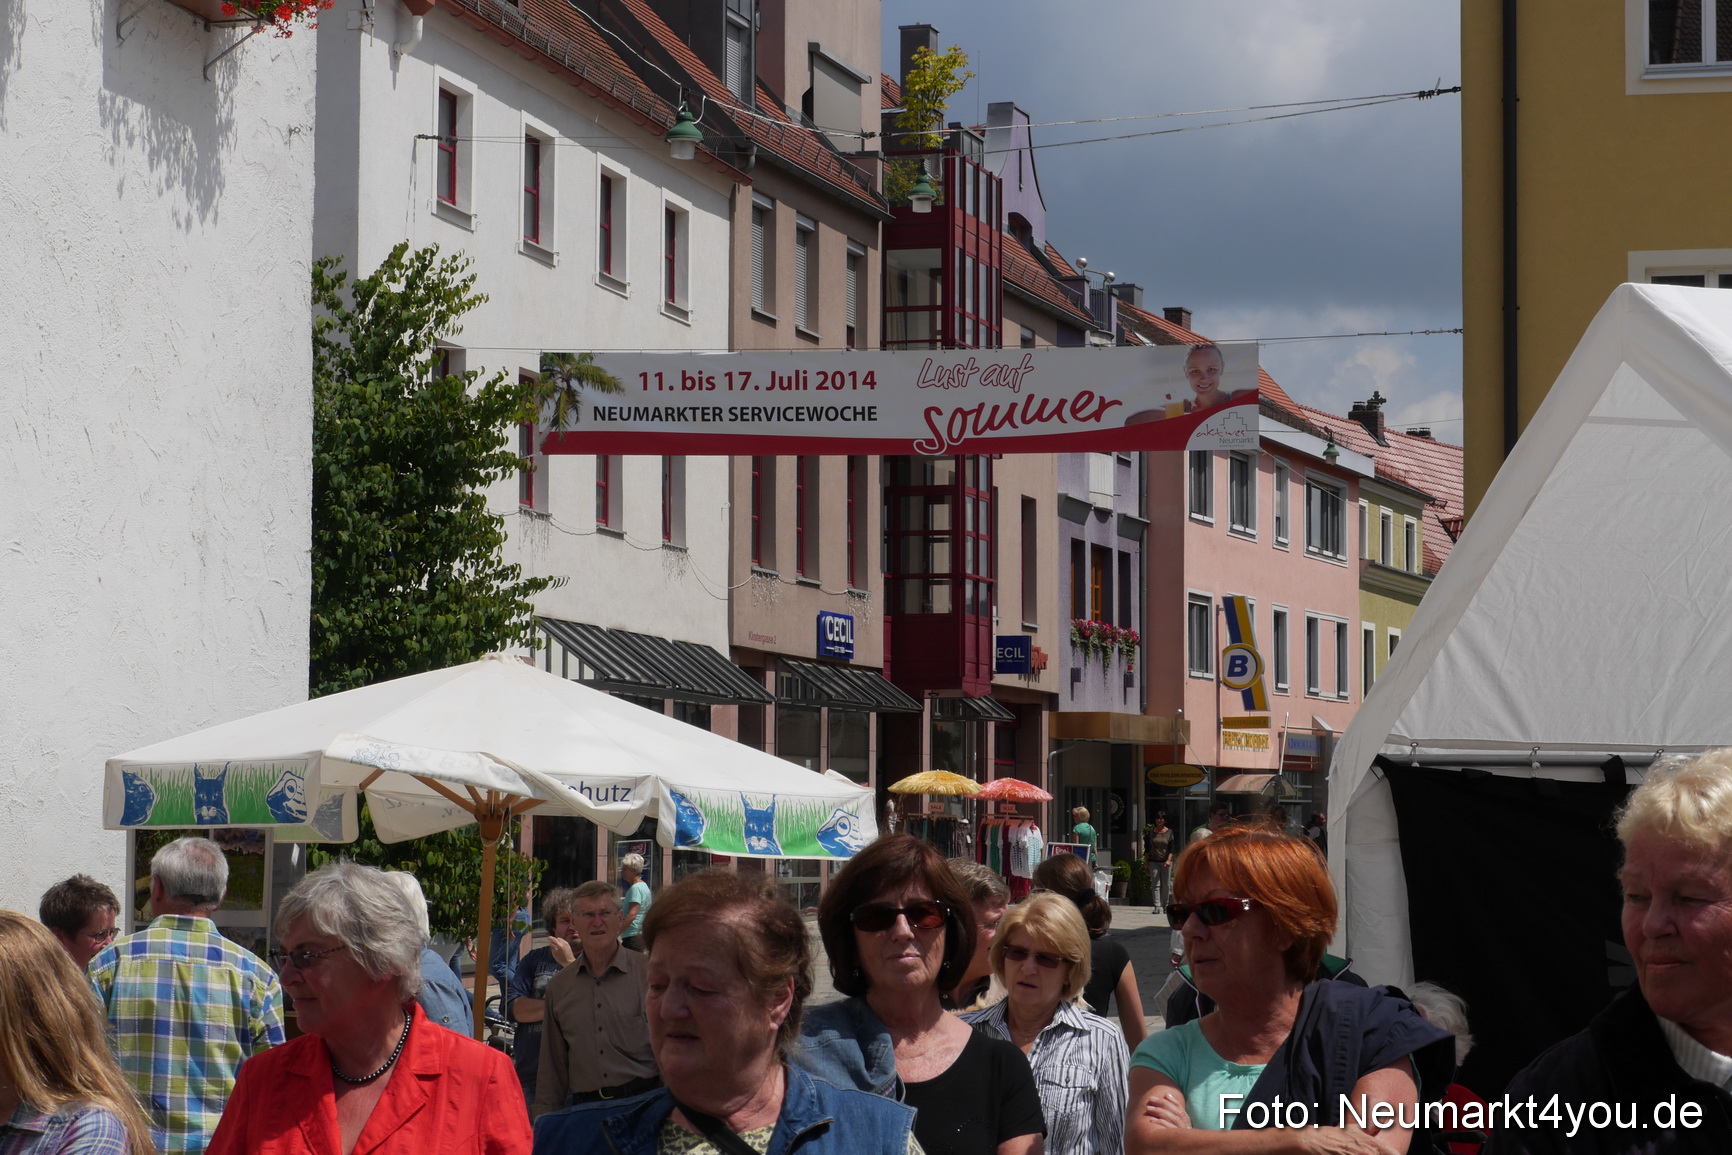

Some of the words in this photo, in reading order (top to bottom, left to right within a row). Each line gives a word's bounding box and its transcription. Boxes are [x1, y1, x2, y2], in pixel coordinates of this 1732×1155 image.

[639, 371, 675, 392] 11.
[680, 369, 717, 392] bis
[724, 371, 761, 391] 17.
[765, 369, 809, 392] Juli
[815, 370, 877, 391] 2014
[916, 356, 980, 390] Lust
[979, 352, 1035, 394] auf
[593, 405, 724, 422] NEUMARKTER
[728, 405, 878, 422] SERVICEWOCHE
[913, 390, 1123, 456] Sommer
[1196, 423, 1245, 438] aktives
[1219, 437, 1254, 445] Neumarkt
[823, 615, 854, 644] CECIL
[996, 647, 1025, 659] ECIL
[1227, 655, 1248, 678] B
